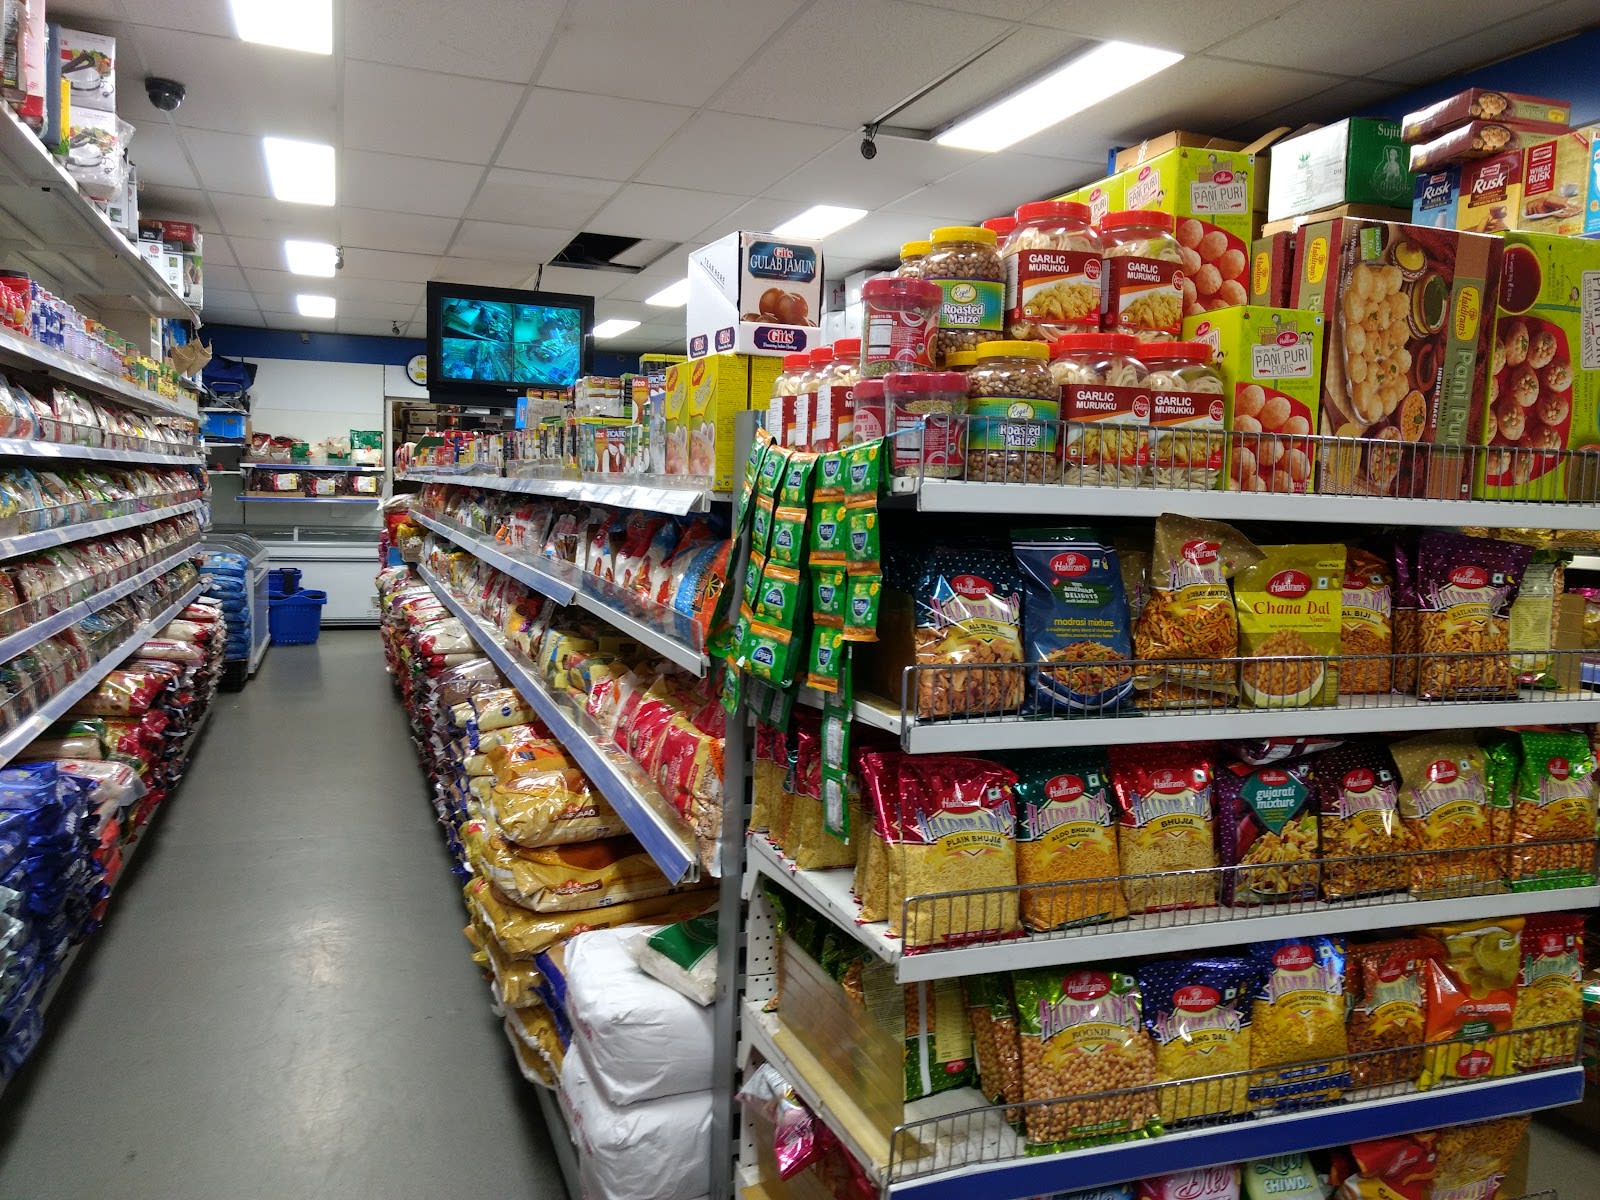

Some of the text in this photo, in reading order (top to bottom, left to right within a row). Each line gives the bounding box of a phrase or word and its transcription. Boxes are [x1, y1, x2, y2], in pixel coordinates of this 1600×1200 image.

[1529, 163, 1551, 175] WHEAT
[1472, 172, 1506, 194] Rusk
[1528, 171, 1551, 184] RUSK
[1194, 186, 1243, 203] PANI PURI
[1423, 181, 1451, 199] Rusk
[773, 247, 793, 259] Gits
[1348, 238, 1357, 265] Weight
[750, 254, 815, 274] GULAB JAMUN
[1028, 253, 1066, 265] GARLIC
[1028, 263, 1069, 273] MURUKKU
[1127, 262, 1158, 274] GARLIC
[1127, 271, 1160, 283] MURUKKU
[942, 303, 984, 317] Roasted
[1457, 290, 1472, 336] Haldiram's
[946, 314, 980, 325] Maize
[767, 329, 795, 344] Gits
[1256, 348, 1308, 367] PANI PURI
[1453, 348, 1473, 400] Pani
[1435, 367, 1443, 398] INDIAN
[1076, 391, 1114, 401] GARLIC
[1155, 396, 1192, 406] GARLIC
[1076, 400, 1117, 411] MURUKKU
[1155, 405, 1195, 415] MURUKKU
[1253, 600, 1330, 615] Chana Dal
[1054, 618, 1114, 627] madrasi mixture
[1256, 786, 1296, 800] gujarati
[1256, 798, 1295, 809] mixture
[1161, 818, 1195, 828] BHUJIA
[946, 836, 969, 847] PLAIN
[971, 835, 1001, 843] BHUJIA
[1212, 1034, 1227, 1042] DAL
